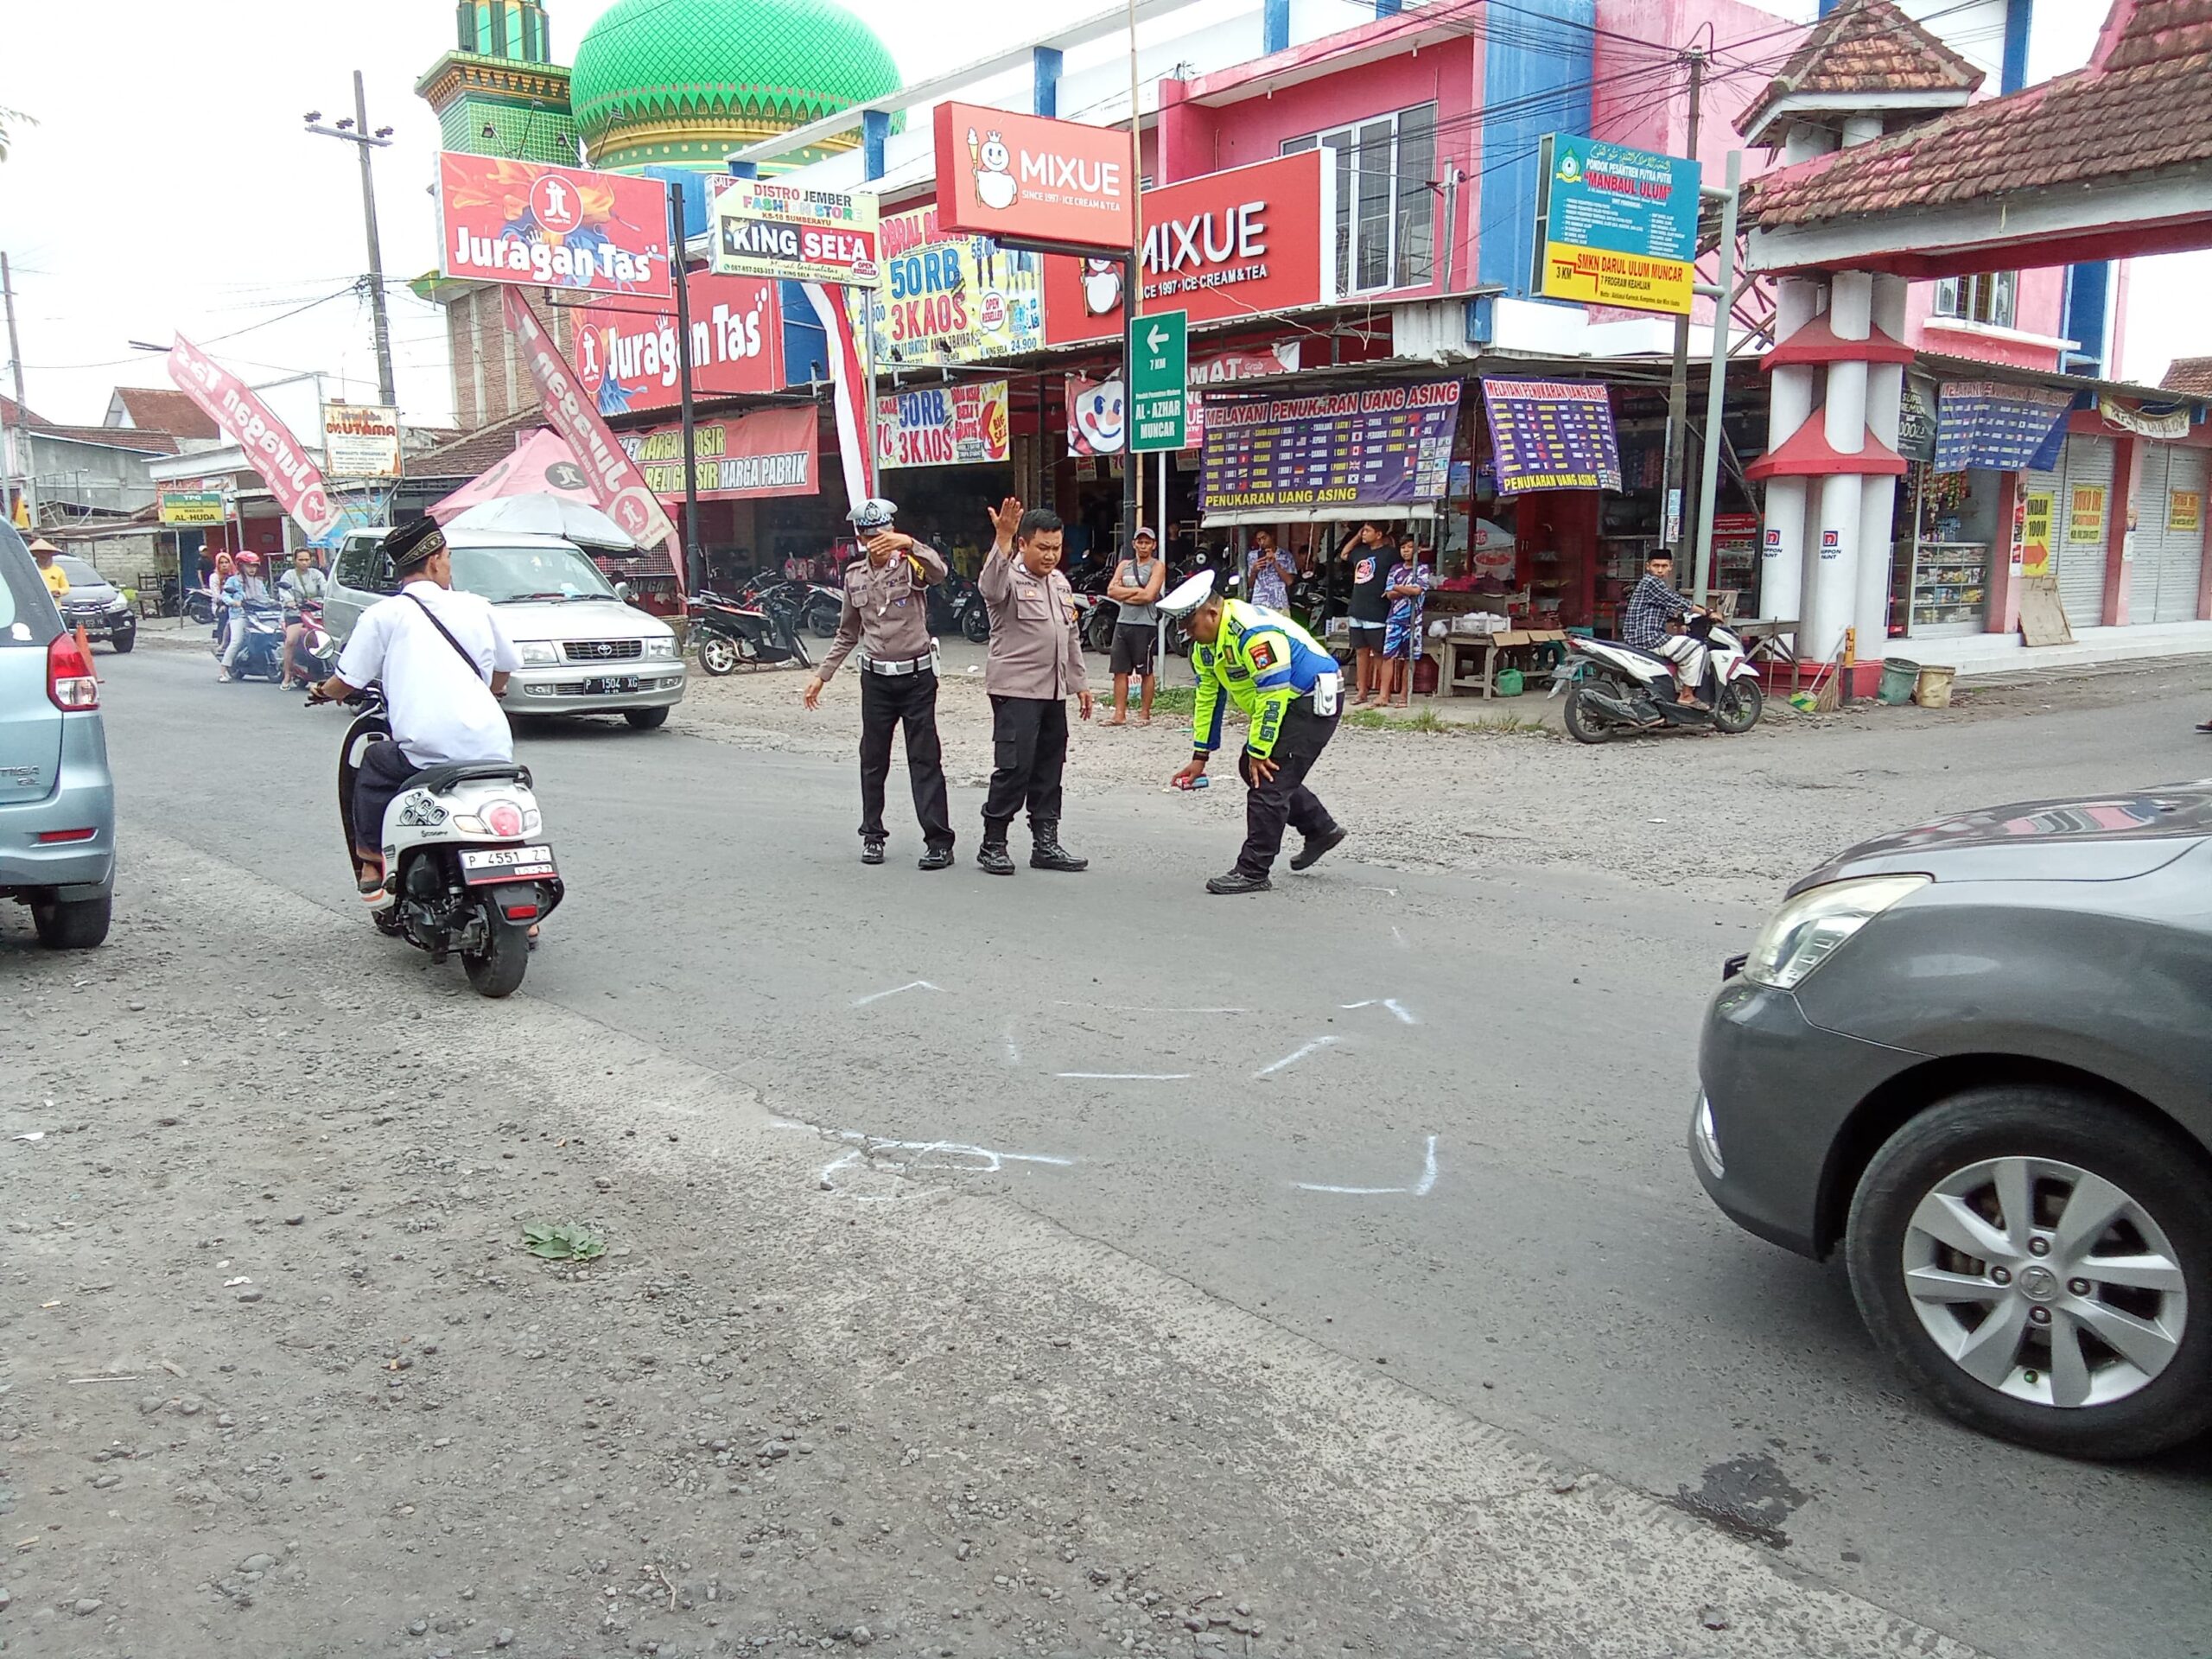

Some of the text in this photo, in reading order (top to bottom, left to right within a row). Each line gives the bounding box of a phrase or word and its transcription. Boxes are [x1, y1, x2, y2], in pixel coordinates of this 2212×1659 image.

[1020, 149, 1121, 197] MIXUE
[1586, 158, 1608, 173] PONDOK
[1609, 162, 1639, 178] PESANTREN
[714, 175, 732, 188] SALE
[754, 184, 852, 207] DISTRO JEMBER
[1022, 191, 1044, 201] SINCE
[1045, 194, 1058, 203] 1997
[1062, 196, 1074, 206] ICE
[1074, 198, 1100, 209] CREAM
[1106, 201, 1121, 212] TEA
[743, 196, 862, 222] FASHION STORE
[734, 224, 868, 263] KING SELA
[455, 227, 652, 283] Juragan Tas
[890, 247, 960, 300] 50RB
[1556, 266, 1572, 280] 3 KM
[1578, 253, 1683, 283] SMKN DARUL ULUM MUNCAR
[1159, 280, 1178, 296] 1997
[1182, 276, 1198, 292] ICE
[1199, 269, 1236, 288] CREAM
[1245, 264, 1268, 280] TEA
[1605, 276, 1627, 289] PROGRAM
[1628, 279, 1650, 290] KEAHLIAN
[985, 296, 999, 311] OPEN
[712, 303, 761, 362] Tas
[1011, 338, 1037, 352] 24.900
[1149, 358, 1166, 371] 7 KM
[899, 389, 945, 428] 50RB
[1135, 404, 1147, 421] AL
[1152, 400, 1181, 417] AZHAR
[1205, 403, 1269, 429] MELAYANI
[1271, 391, 1359, 423] PENUKARAN
[1361, 389, 1405, 413] UANG
[1406, 383, 1459, 410] ASING
[342, 423, 396, 436] UTAMA
[1140, 421, 1175, 439] MUNCAR
[643, 451, 809, 495] BELI GRSIR HARGA PABRIK
[1504, 474, 1598, 491] PENUKARAN UANG ASING
[1205, 487, 1357, 507] PENUKARAN UANG ASING
[586, 677, 638, 690] P 1504 XG
[1259, 701, 1281, 743] POLISI
[0, 766, 40, 777] TIGA
[468, 855, 476, 867] P
[487, 851, 519, 865] 4551
